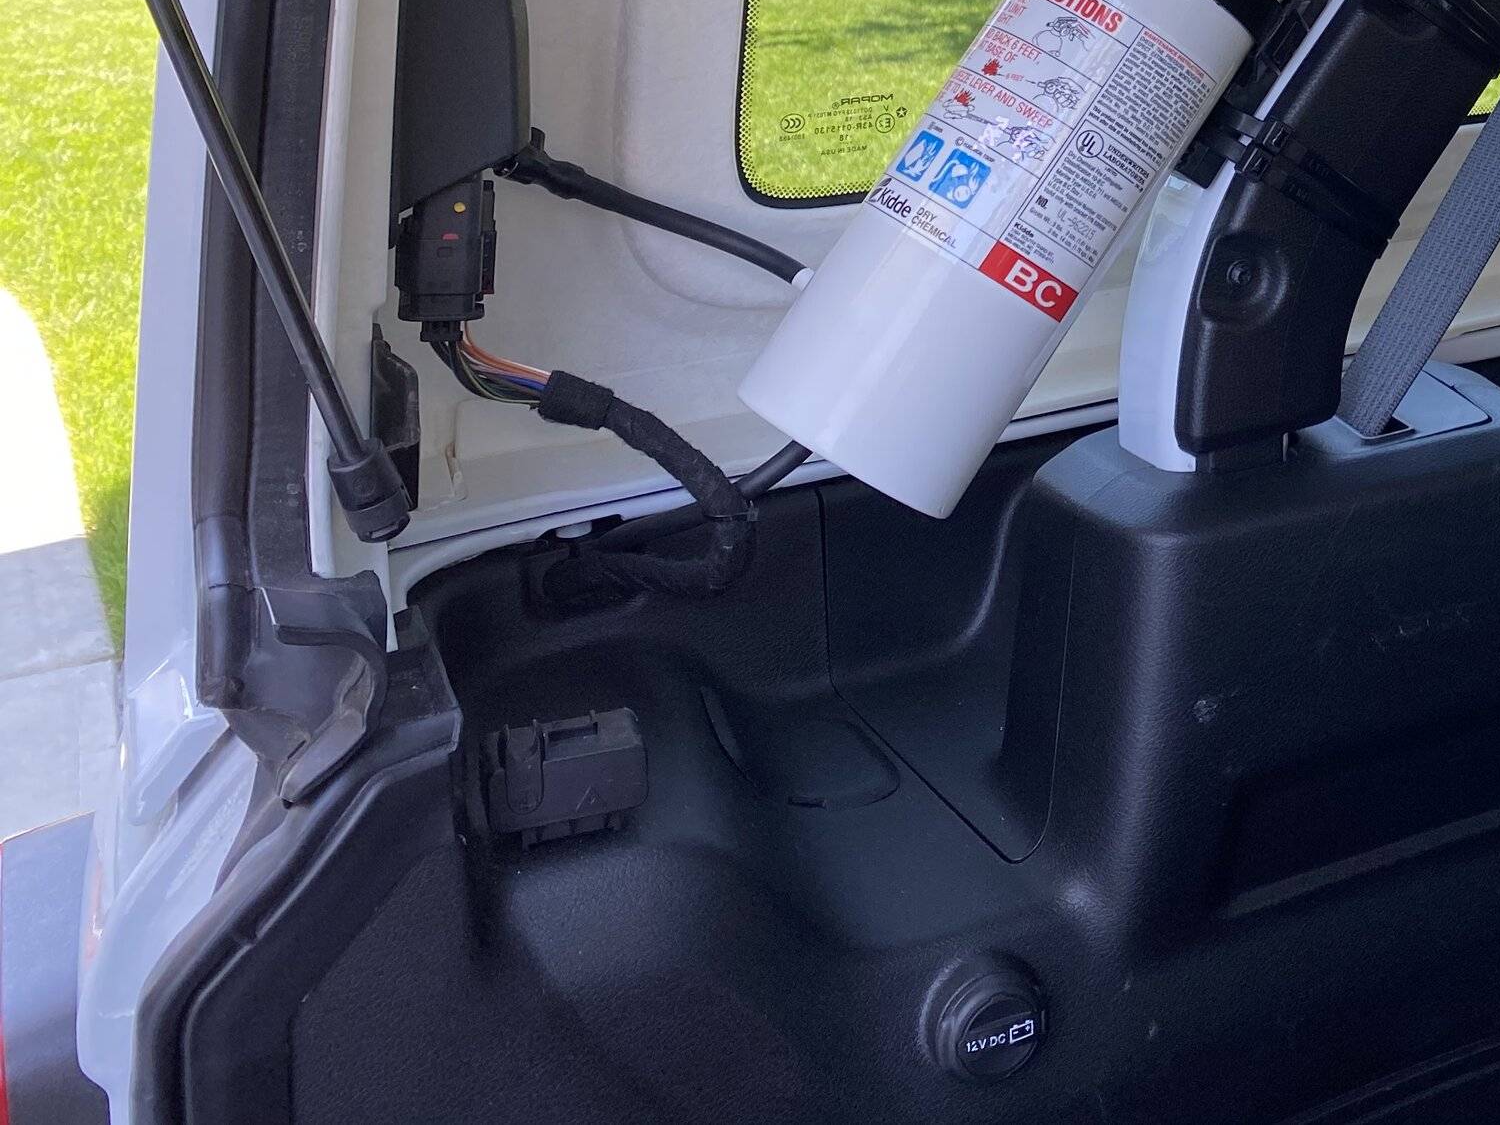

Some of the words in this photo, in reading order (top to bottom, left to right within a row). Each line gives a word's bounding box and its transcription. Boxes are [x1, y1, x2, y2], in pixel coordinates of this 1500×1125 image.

[984, 41, 1006, 58] BASE
[1002, 50, 1018, 64] OF
[991, 30, 1013, 47] BACK
[1009, 39, 1020, 51] 6
[968, 75, 996, 96] LEVER
[993, 88, 1016, 108] AND
[1014, 101, 1054, 130] SWEEP
[1080, 132, 1100, 155] UL
[876, 187, 915, 219] Kidde
[915, 206, 937, 223] DRY
[910, 214, 959, 248] CHEMICAL
[1003, 258, 1065, 311] BC
